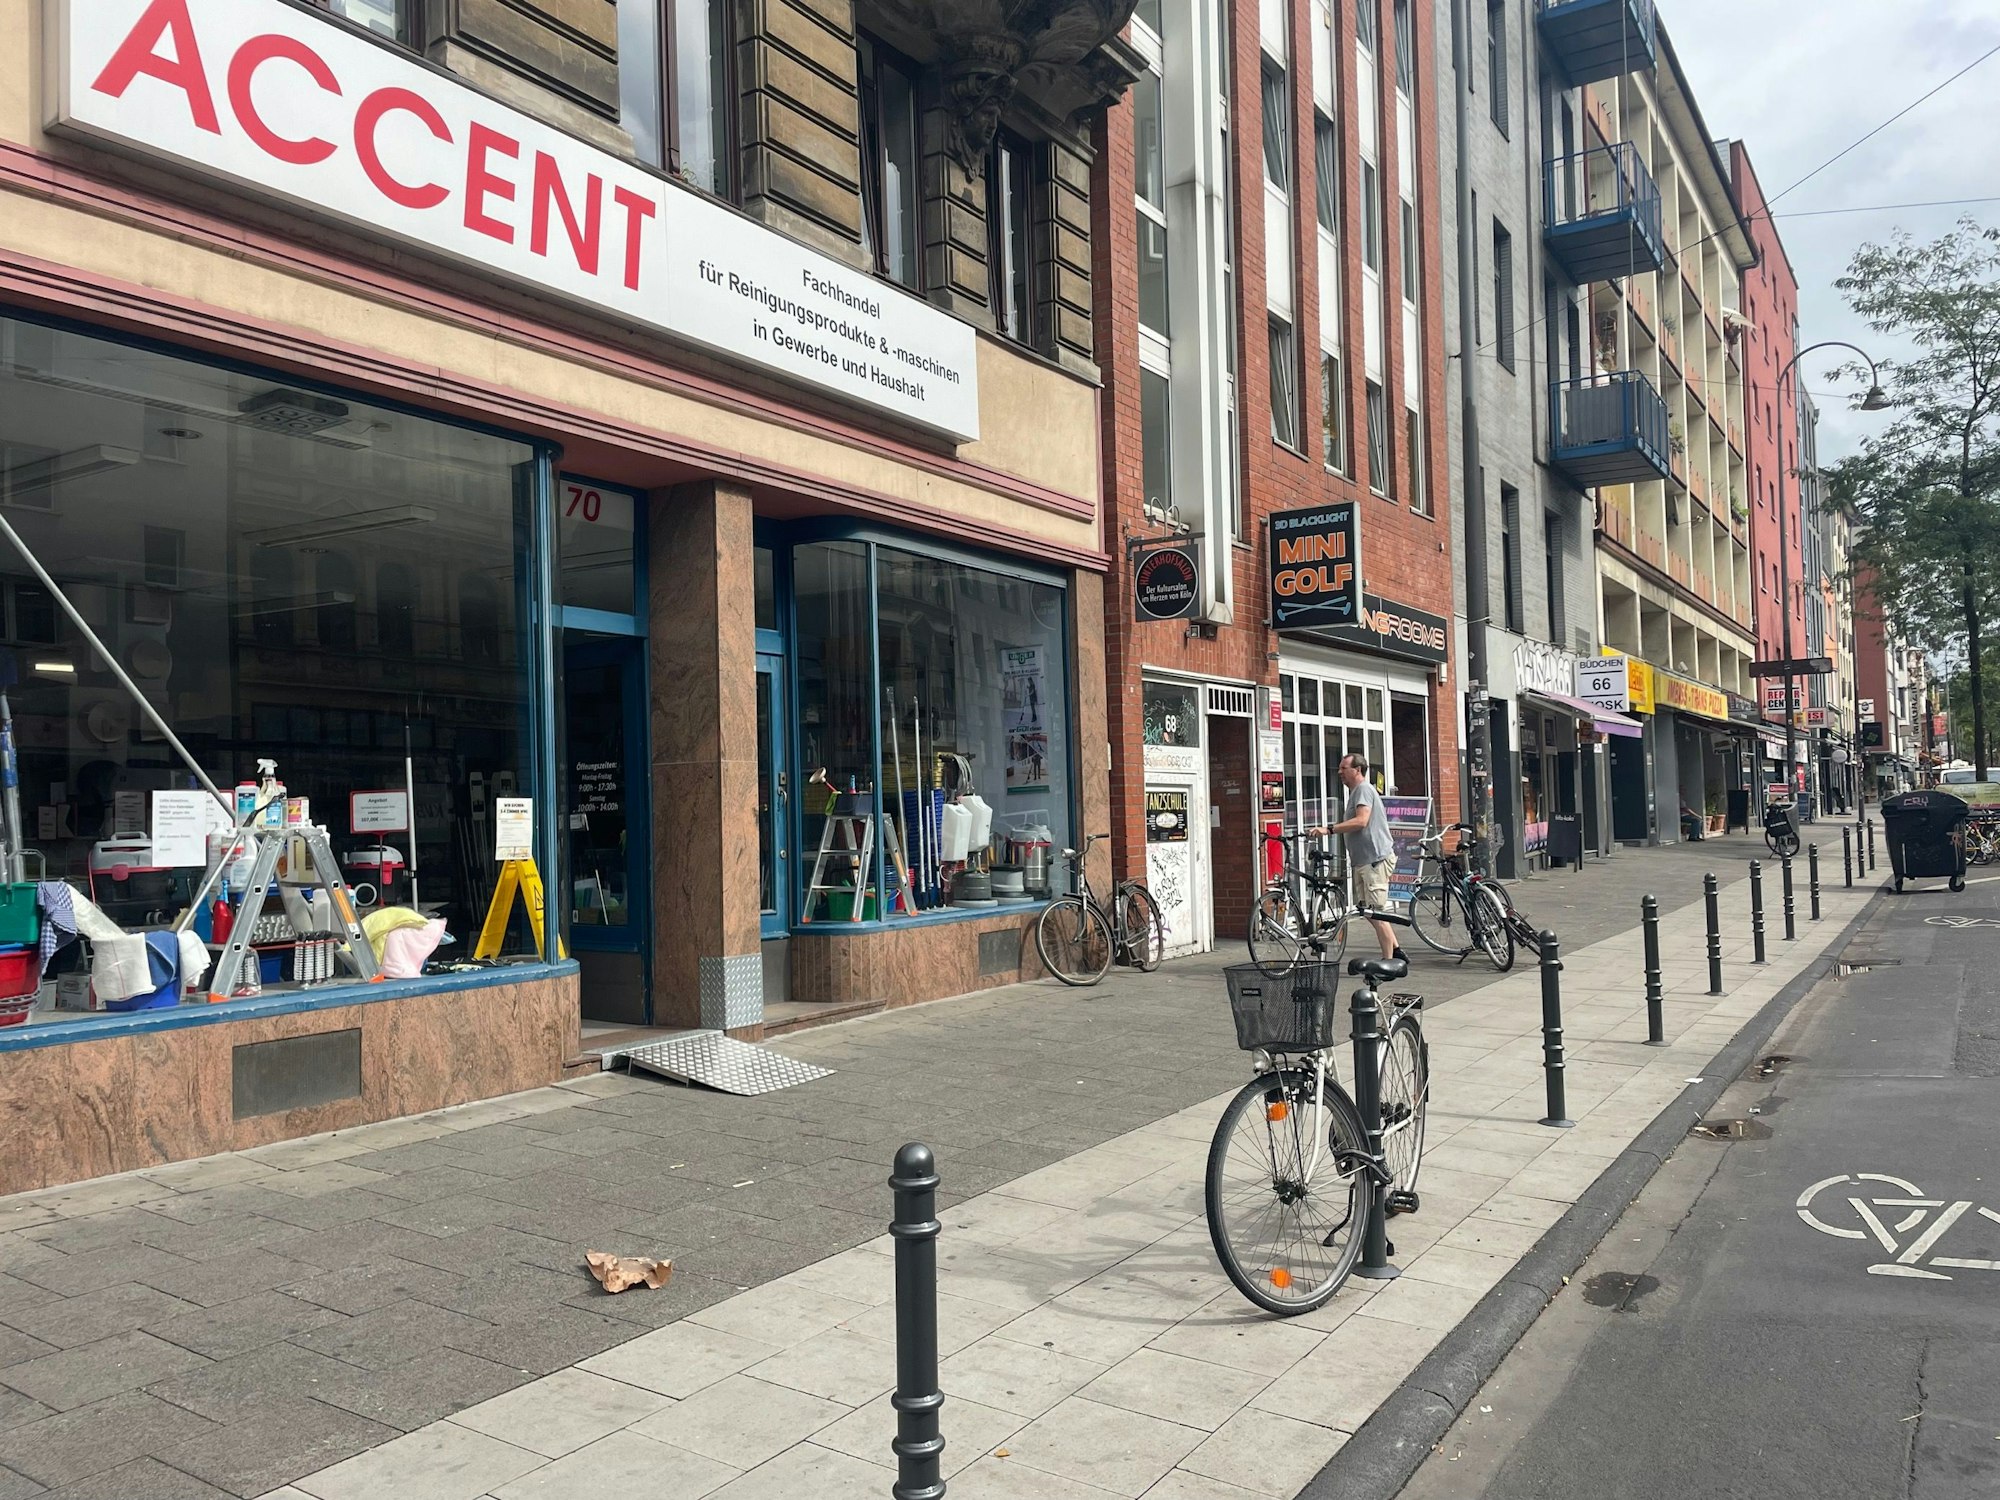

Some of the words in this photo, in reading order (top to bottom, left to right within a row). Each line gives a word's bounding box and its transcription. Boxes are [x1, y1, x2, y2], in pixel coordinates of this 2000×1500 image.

[92, 0, 655, 291] ACCENT
[803, 269, 880, 319] Fachhandel
[699, 260, 723, 286] für
[729, 272, 875, 348] Reinigungsprodukte
[879, 336, 889, 355] &
[892, 347, 960, 384] -maschinen
[753, 319, 767, 341] in
[772, 327, 837, 367] Gewerbe
[842, 356, 866, 379] und
[870, 365, 924, 401] Haushalt
[566, 486, 601, 522] 70
[1275, 520, 1288, 530] 3D
[1289, 511, 1349, 530] BLACKLIGHT
[1279, 531, 1345, 565] MINI
[1139, 553, 1193, 585] HINTERHOFSALON
[1274, 563, 1353, 596] GOLF
[1141, 595, 1149, 603] im
[1150, 593, 1168, 602] Herzen
[1169, 592, 1179, 600] von
[1180, 590, 1192, 599] Köln
[1146, 586, 1155, 594] Der
[1157, 583, 1187, 593] Kultursalon
[1580, 659, 1623, 669] BÜDCHEN
[1592, 678, 1611, 691] 66
[1768, 690, 1799, 699] REPR
[1708, 692, 1723, 716] PIZZA
[1165, 714, 1177, 733] 68
[1145, 793, 1187, 810] TANZSCHULE
